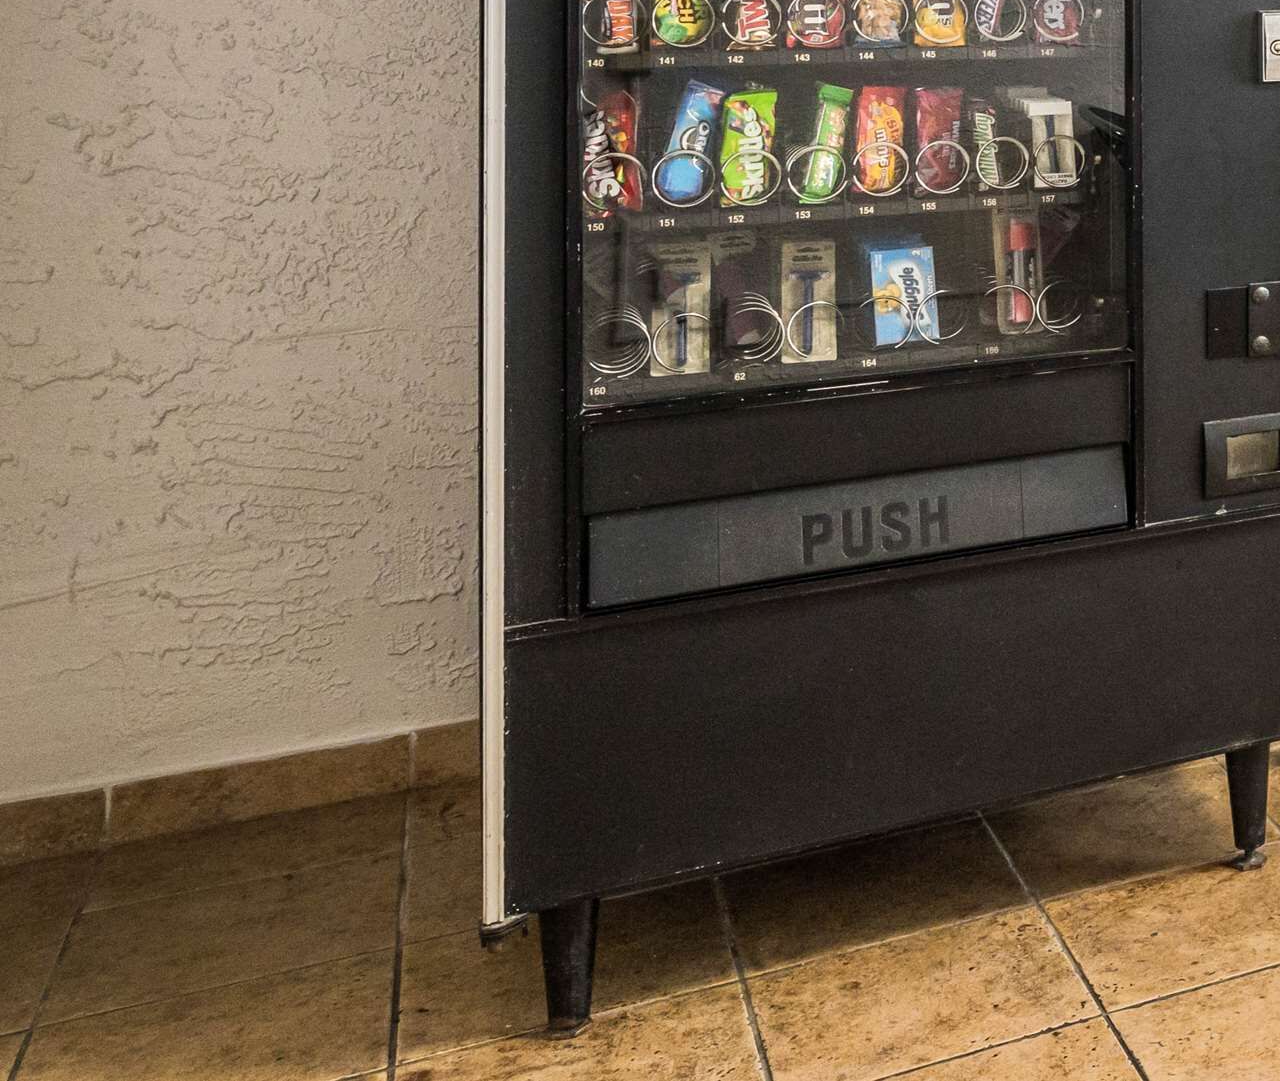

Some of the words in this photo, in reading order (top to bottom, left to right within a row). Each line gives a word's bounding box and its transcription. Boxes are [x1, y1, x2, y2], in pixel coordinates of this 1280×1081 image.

[858, 52, 875, 60] 144
[920, 50, 937, 58] 145
[1040, 48, 1055, 56] 147
[659, 56, 676, 65] 141
[727, 55, 744, 64] 142
[794, 54, 811, 62] 143
[587, 58, 605, 68] 140
[1041, 194, 1055, 203] 157
[859, 206, 875, 215] 154
[921, 202, 937, 211] 155
[727, 214, 745, 224] 152
[794, 210, 811, 219] 153
[586, 222, 605, 232] 150
[658, 218, 675, 227] 151
[861, 358, 877, 368] 164
[588, 386, 606, 396] 160
[802, 495, 949, 565] PUSH
